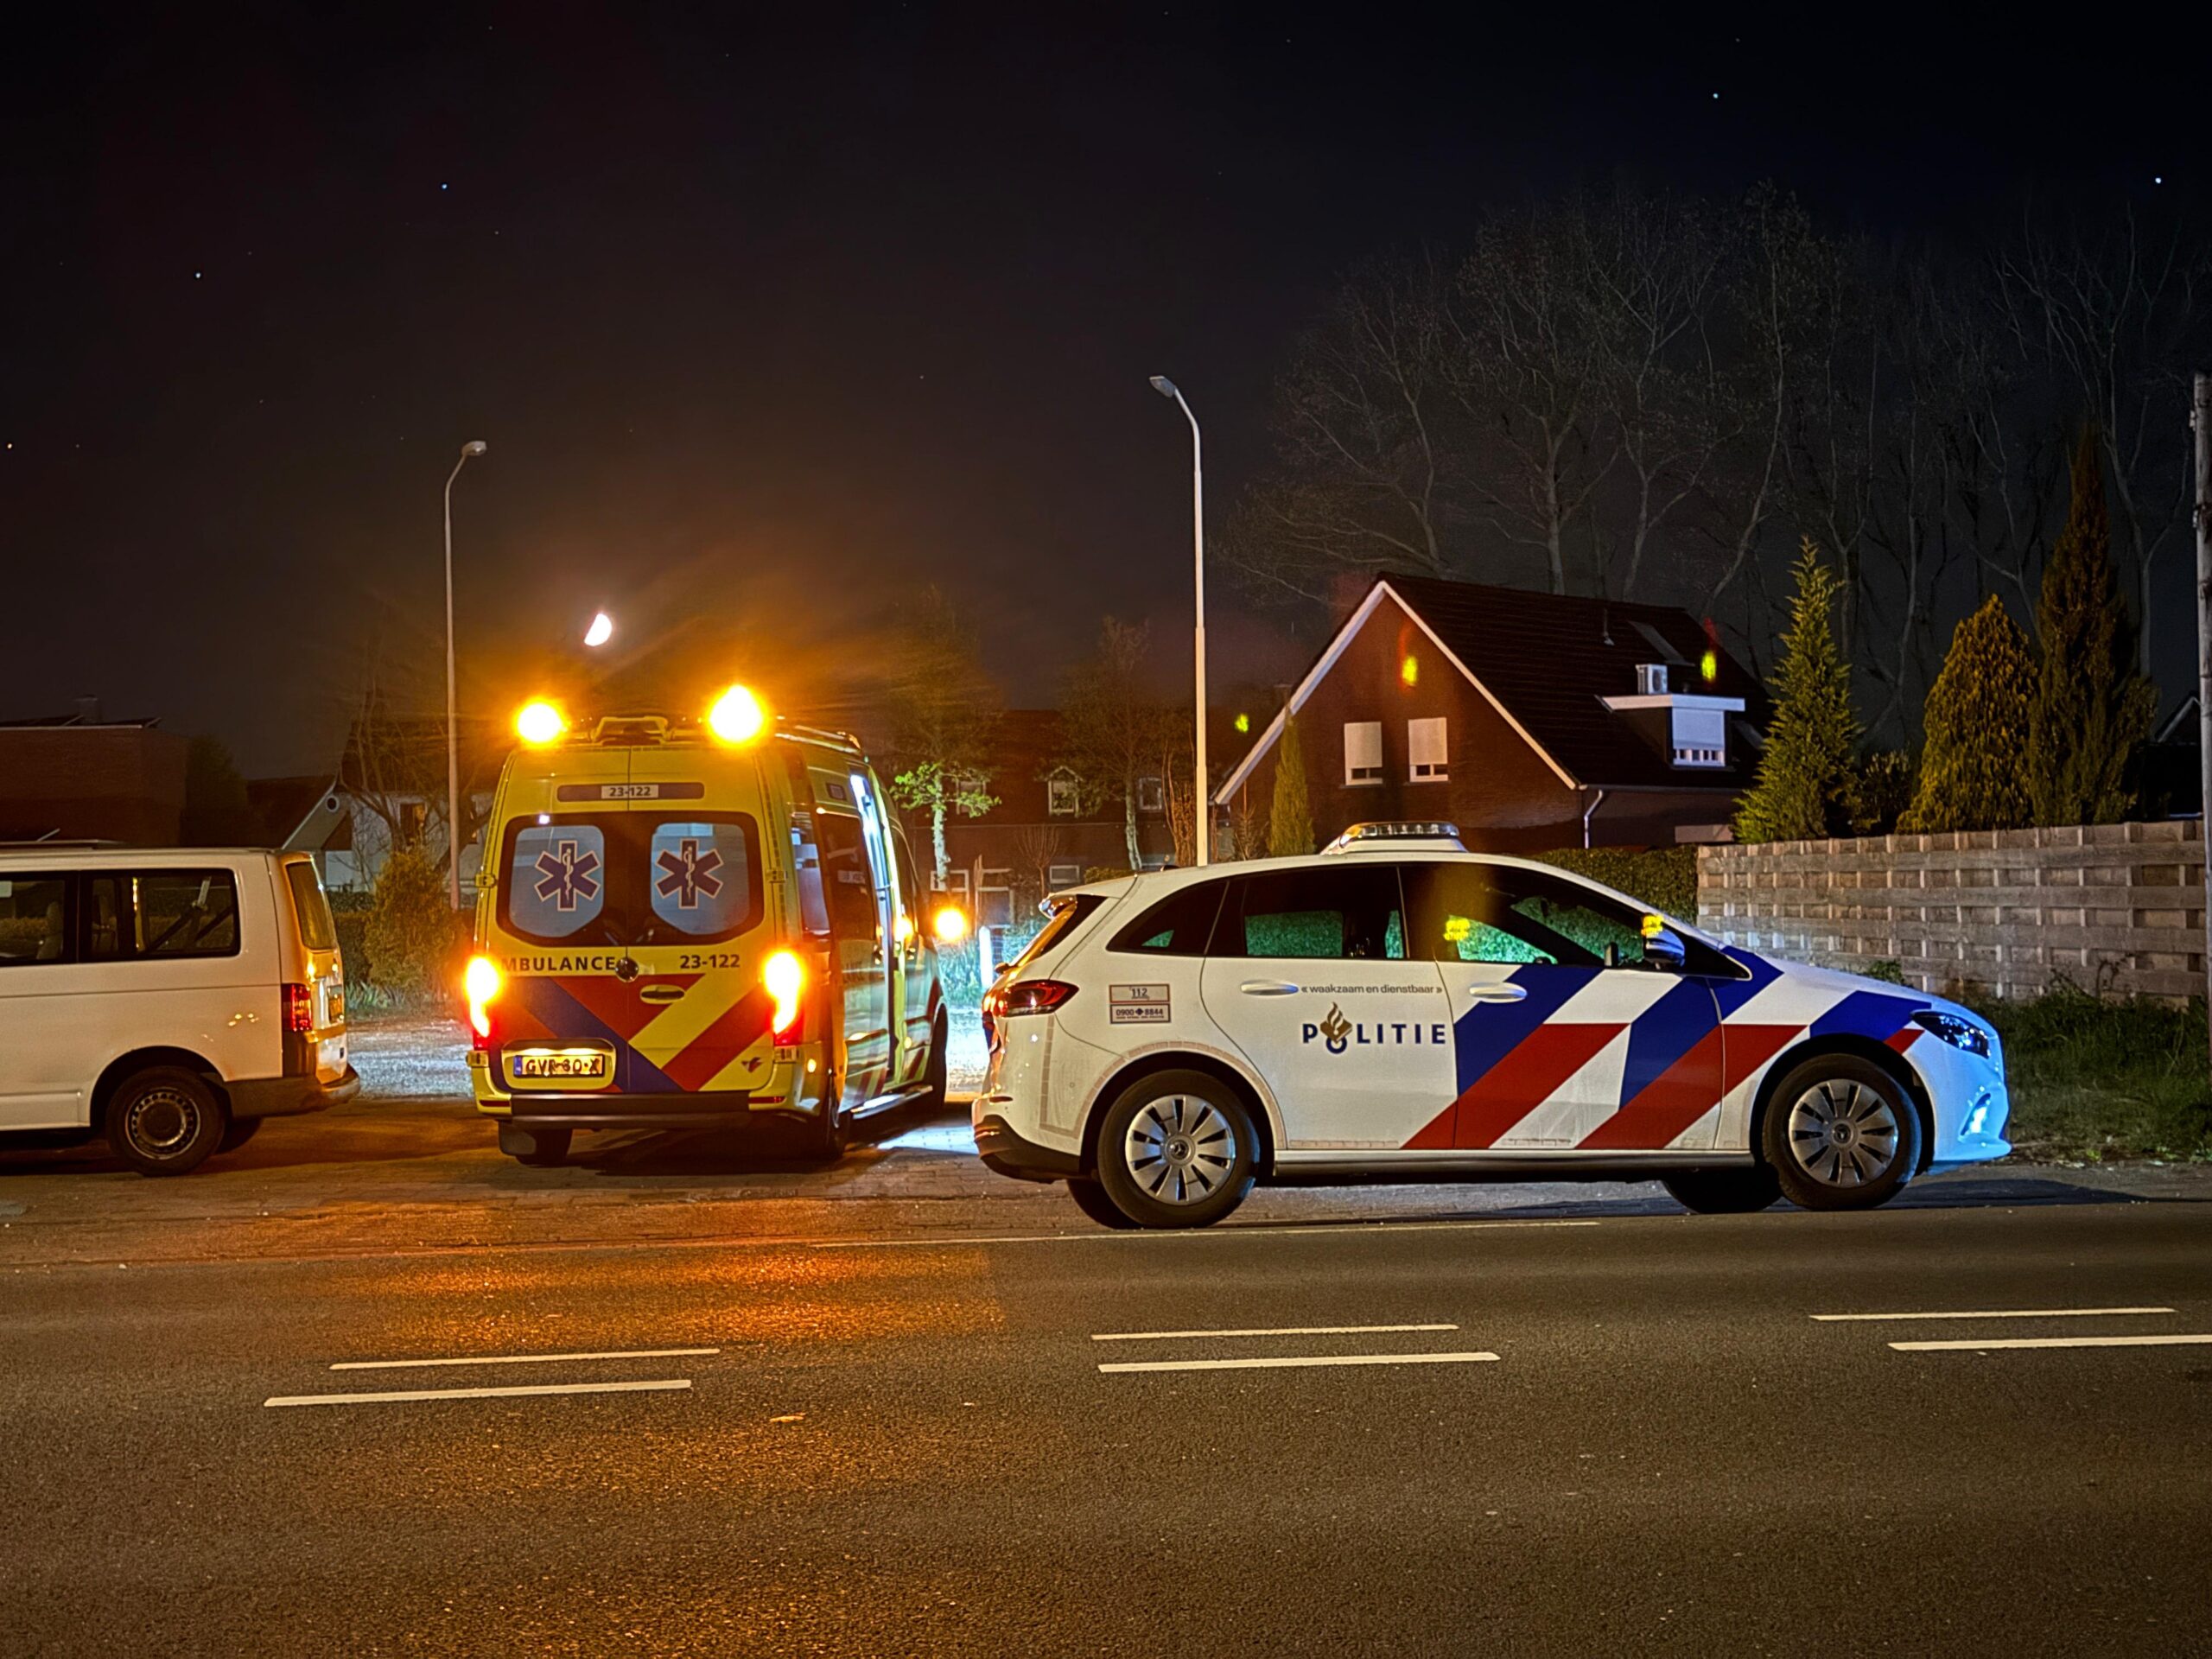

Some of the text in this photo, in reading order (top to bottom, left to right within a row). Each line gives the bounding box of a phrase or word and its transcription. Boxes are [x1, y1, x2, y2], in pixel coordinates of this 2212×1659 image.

[608, 786, 651, 797] 23-122
[501, 956, 616, 972] MBULANCE
[679, 954, 741, 969] 23-122
[1131, 988, 1148, 996] 112
[1309, 984, 1364, 994] waakzaam
[1380, 984, 1434, 994] dienstbaar
[1302, 1023, 1446, 1054] POLITIE
